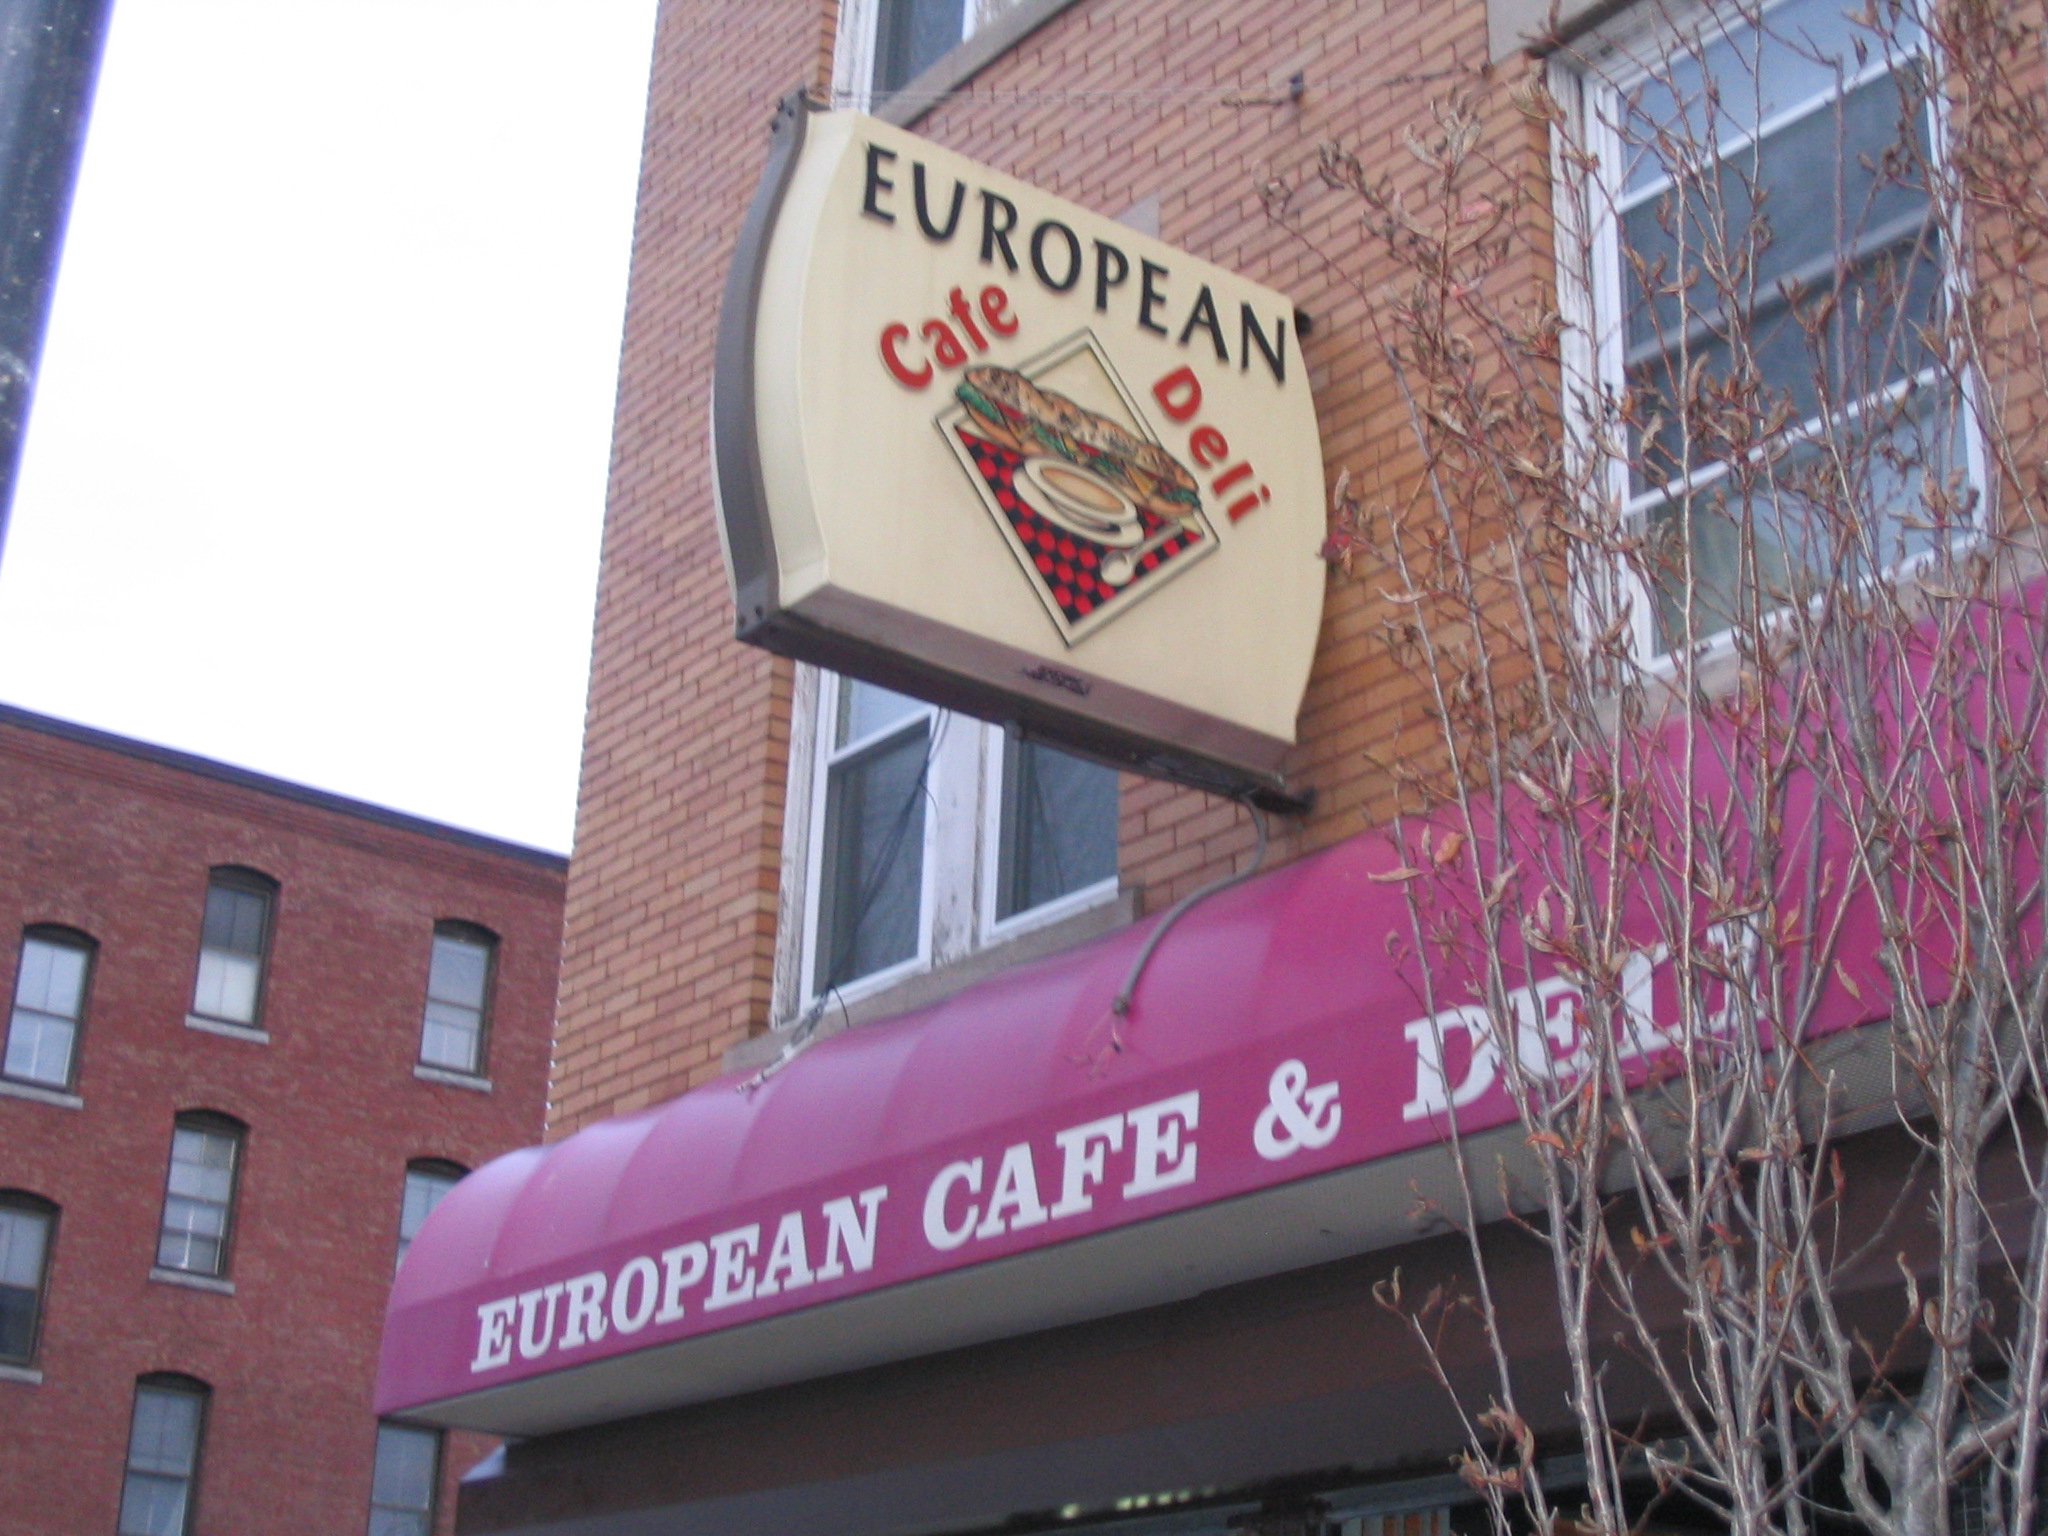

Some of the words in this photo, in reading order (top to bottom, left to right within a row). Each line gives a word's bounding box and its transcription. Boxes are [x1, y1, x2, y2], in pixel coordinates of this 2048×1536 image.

[862, 142, 1286, 384] EUROPEAN
[880, 284, 1019, 390] Cafe
[1152, 364, 1272, 525] Deli
[470, 1185, 888, 1373] EUROPEAN
[922, 1090, 1200, 1251] CAFE
[1253, 1059, 1341, 1160] &
